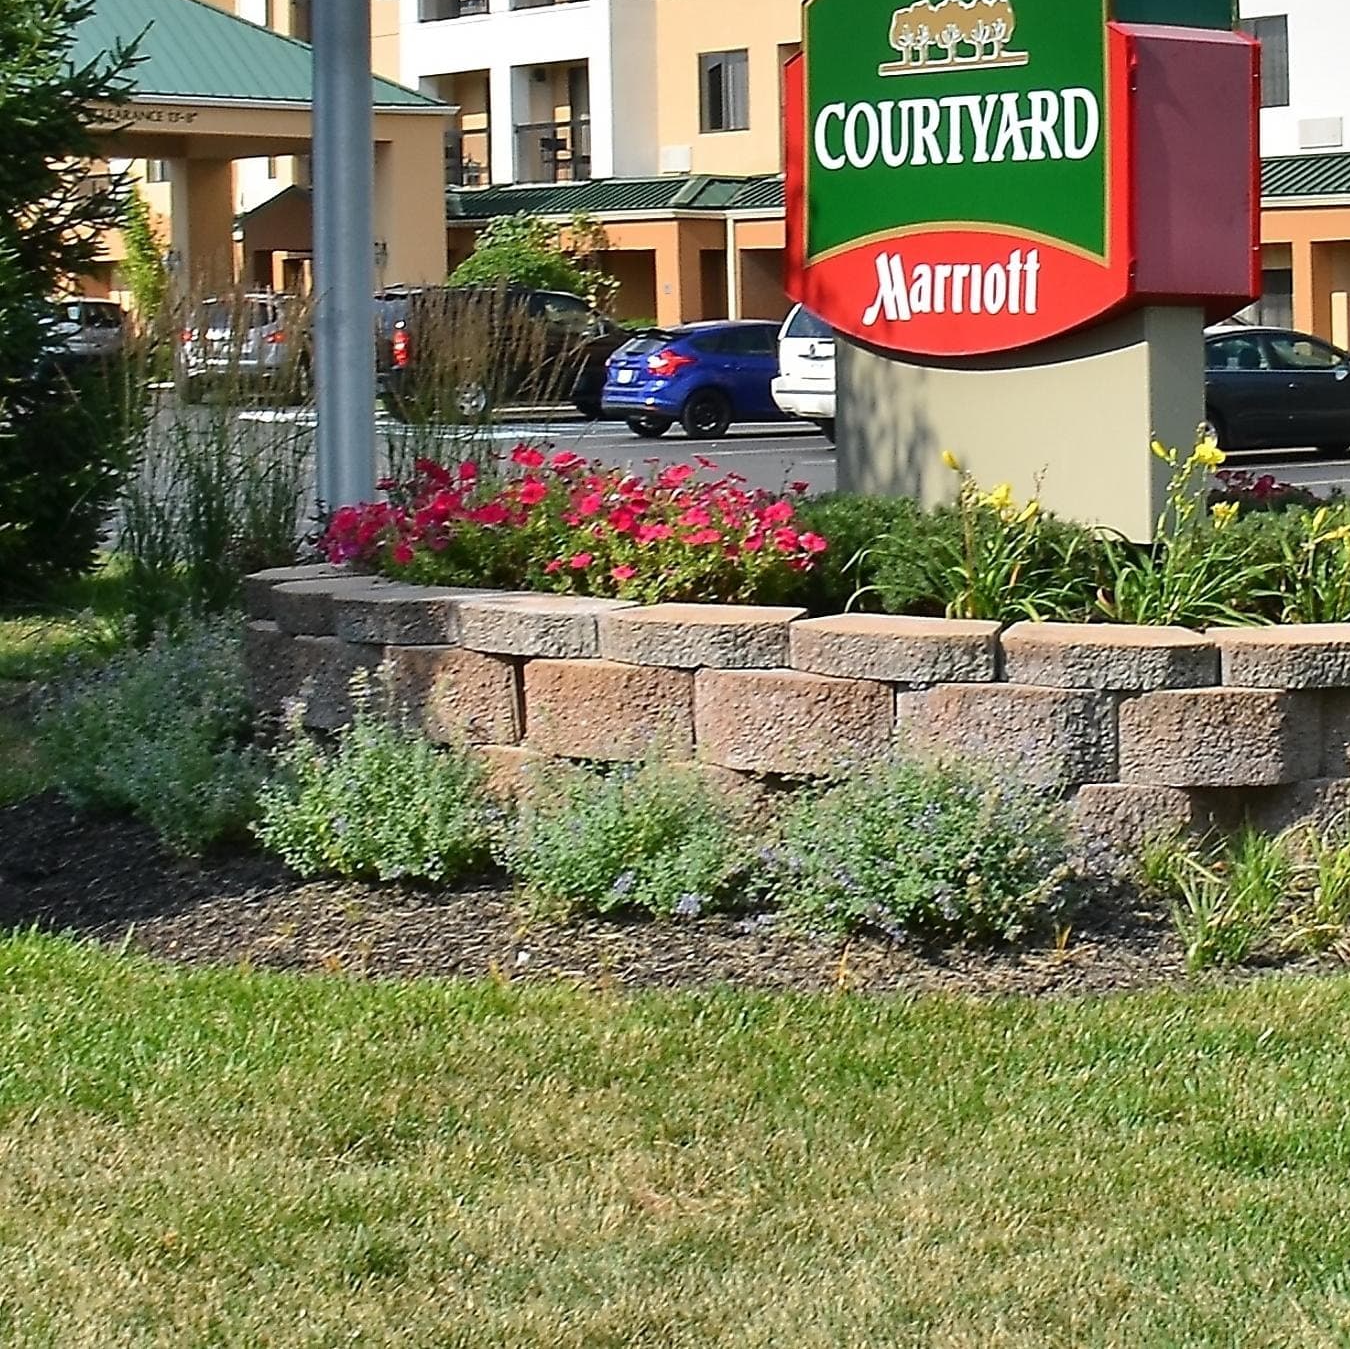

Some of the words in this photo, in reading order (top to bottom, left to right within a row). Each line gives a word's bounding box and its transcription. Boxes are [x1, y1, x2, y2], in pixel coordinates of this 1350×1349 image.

[96, 108, 163, 123] LEARANCE
[814, 87, 1100, 171] COURTYARD
[862, 248, 1041, 326] Marriott
